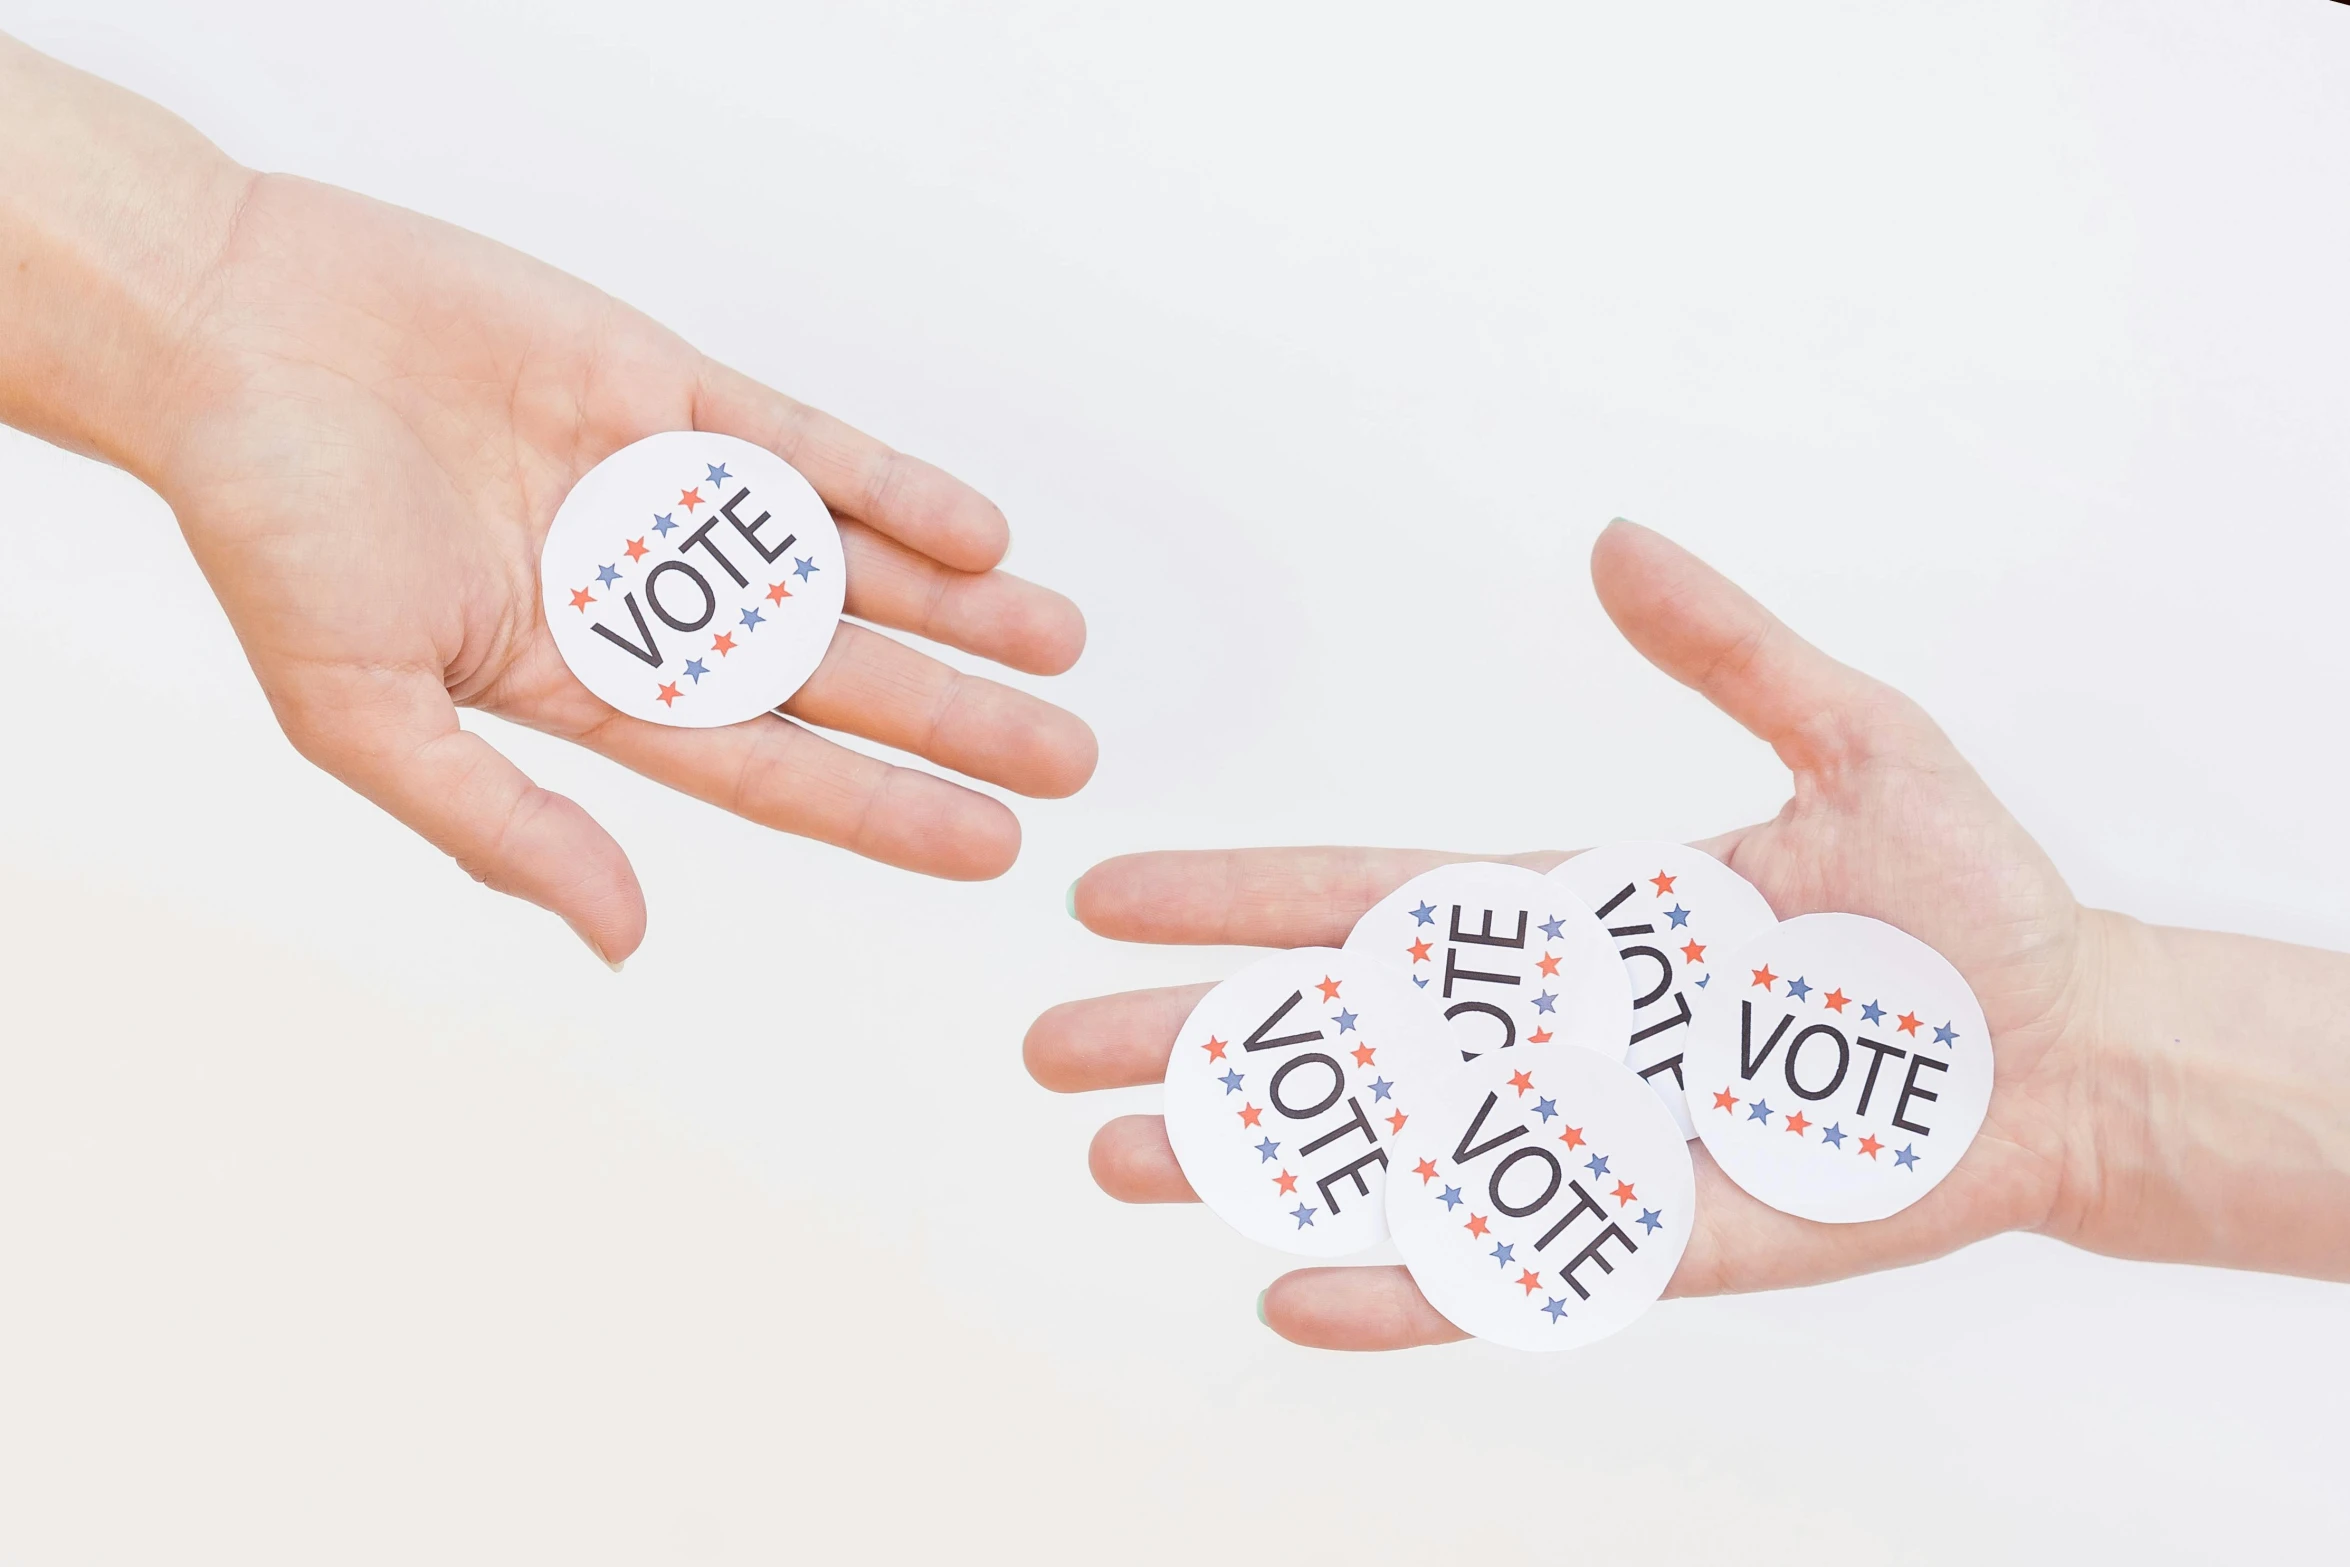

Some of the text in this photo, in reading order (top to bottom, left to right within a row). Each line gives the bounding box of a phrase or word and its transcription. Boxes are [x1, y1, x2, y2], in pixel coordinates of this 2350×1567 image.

[590, 486, 797, 669] VOTE
[1443, 904, 1528, 1063] OTE
[1740, 999, 1949, 1137] VOTE
[1242, 989, 1389, 1216] VOTE
[1451, 1090, 1639, 1301] VOTE
